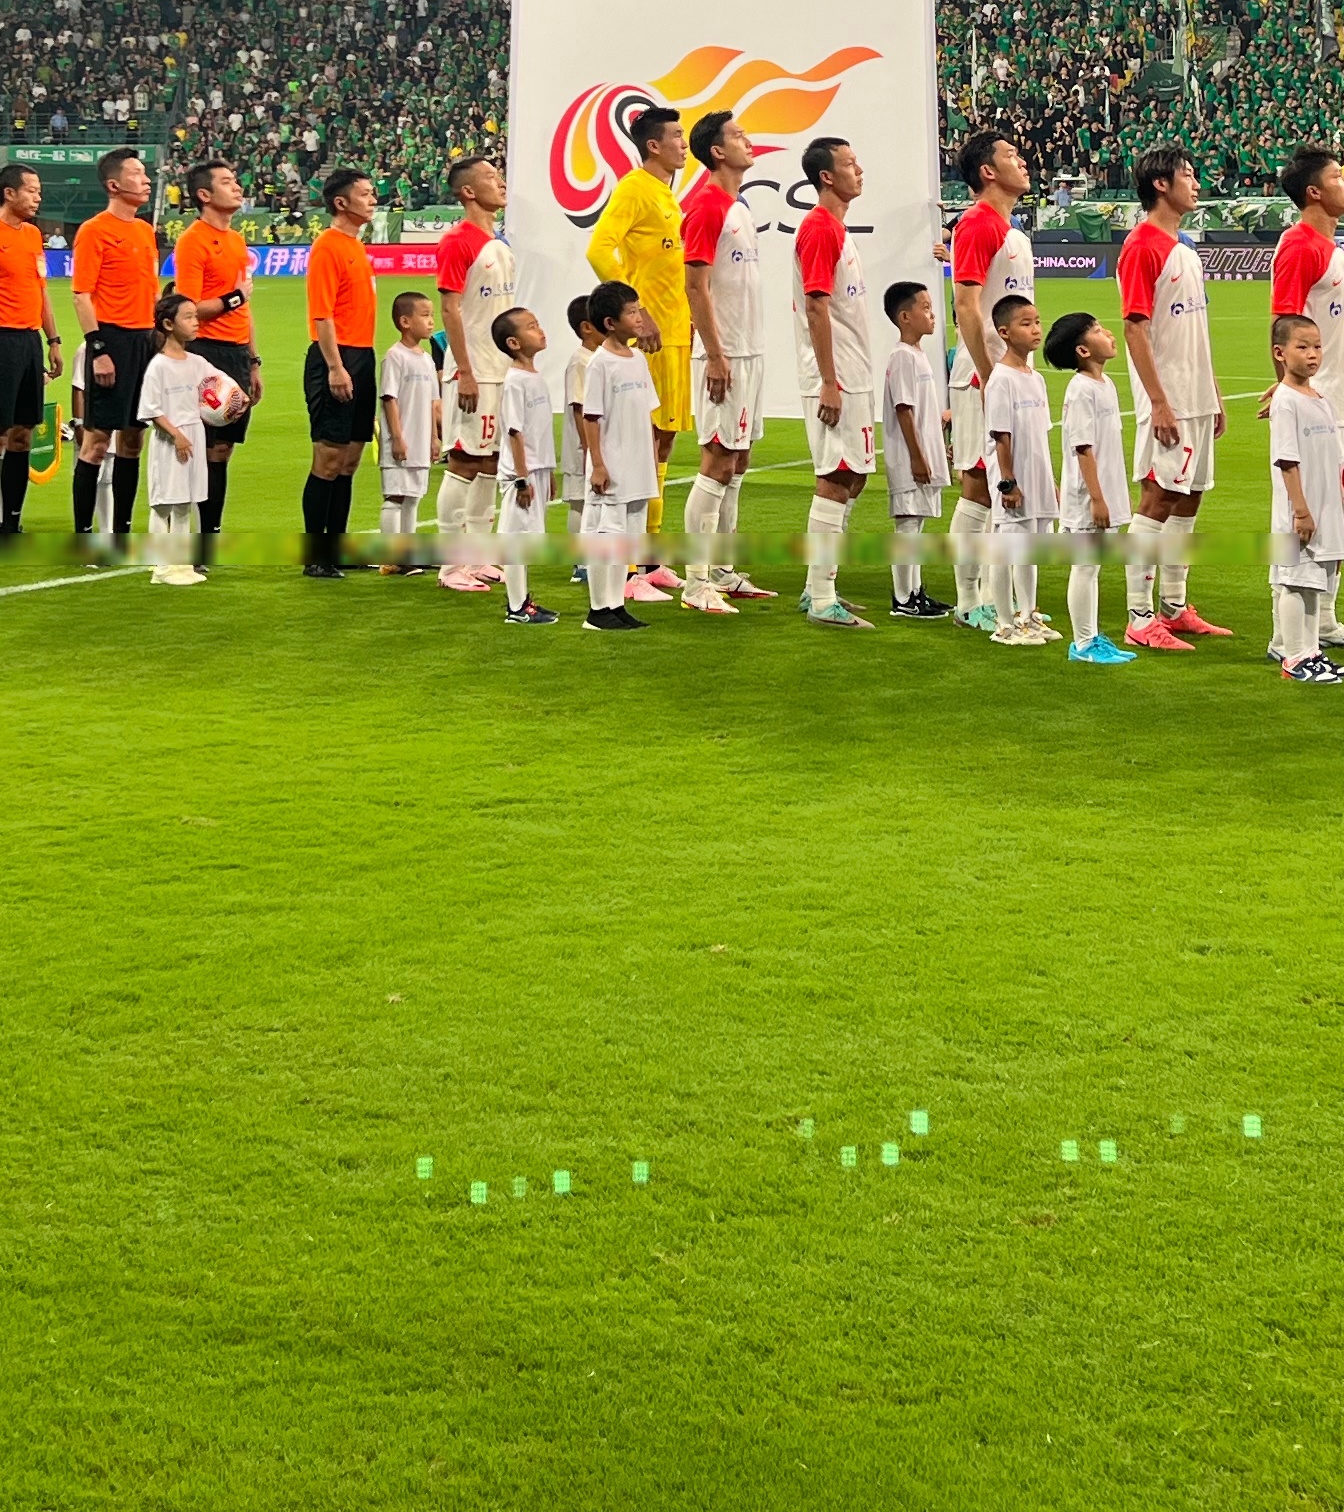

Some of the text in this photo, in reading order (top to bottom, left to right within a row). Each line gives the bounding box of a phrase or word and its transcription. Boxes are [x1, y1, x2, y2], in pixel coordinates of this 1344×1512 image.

[1200, 248, 1275, 272] FUTUR
[481, 415, 495, 439] 15
[739, 407, 748, 434] 4
[1182, 447, 1193, 475] 7
